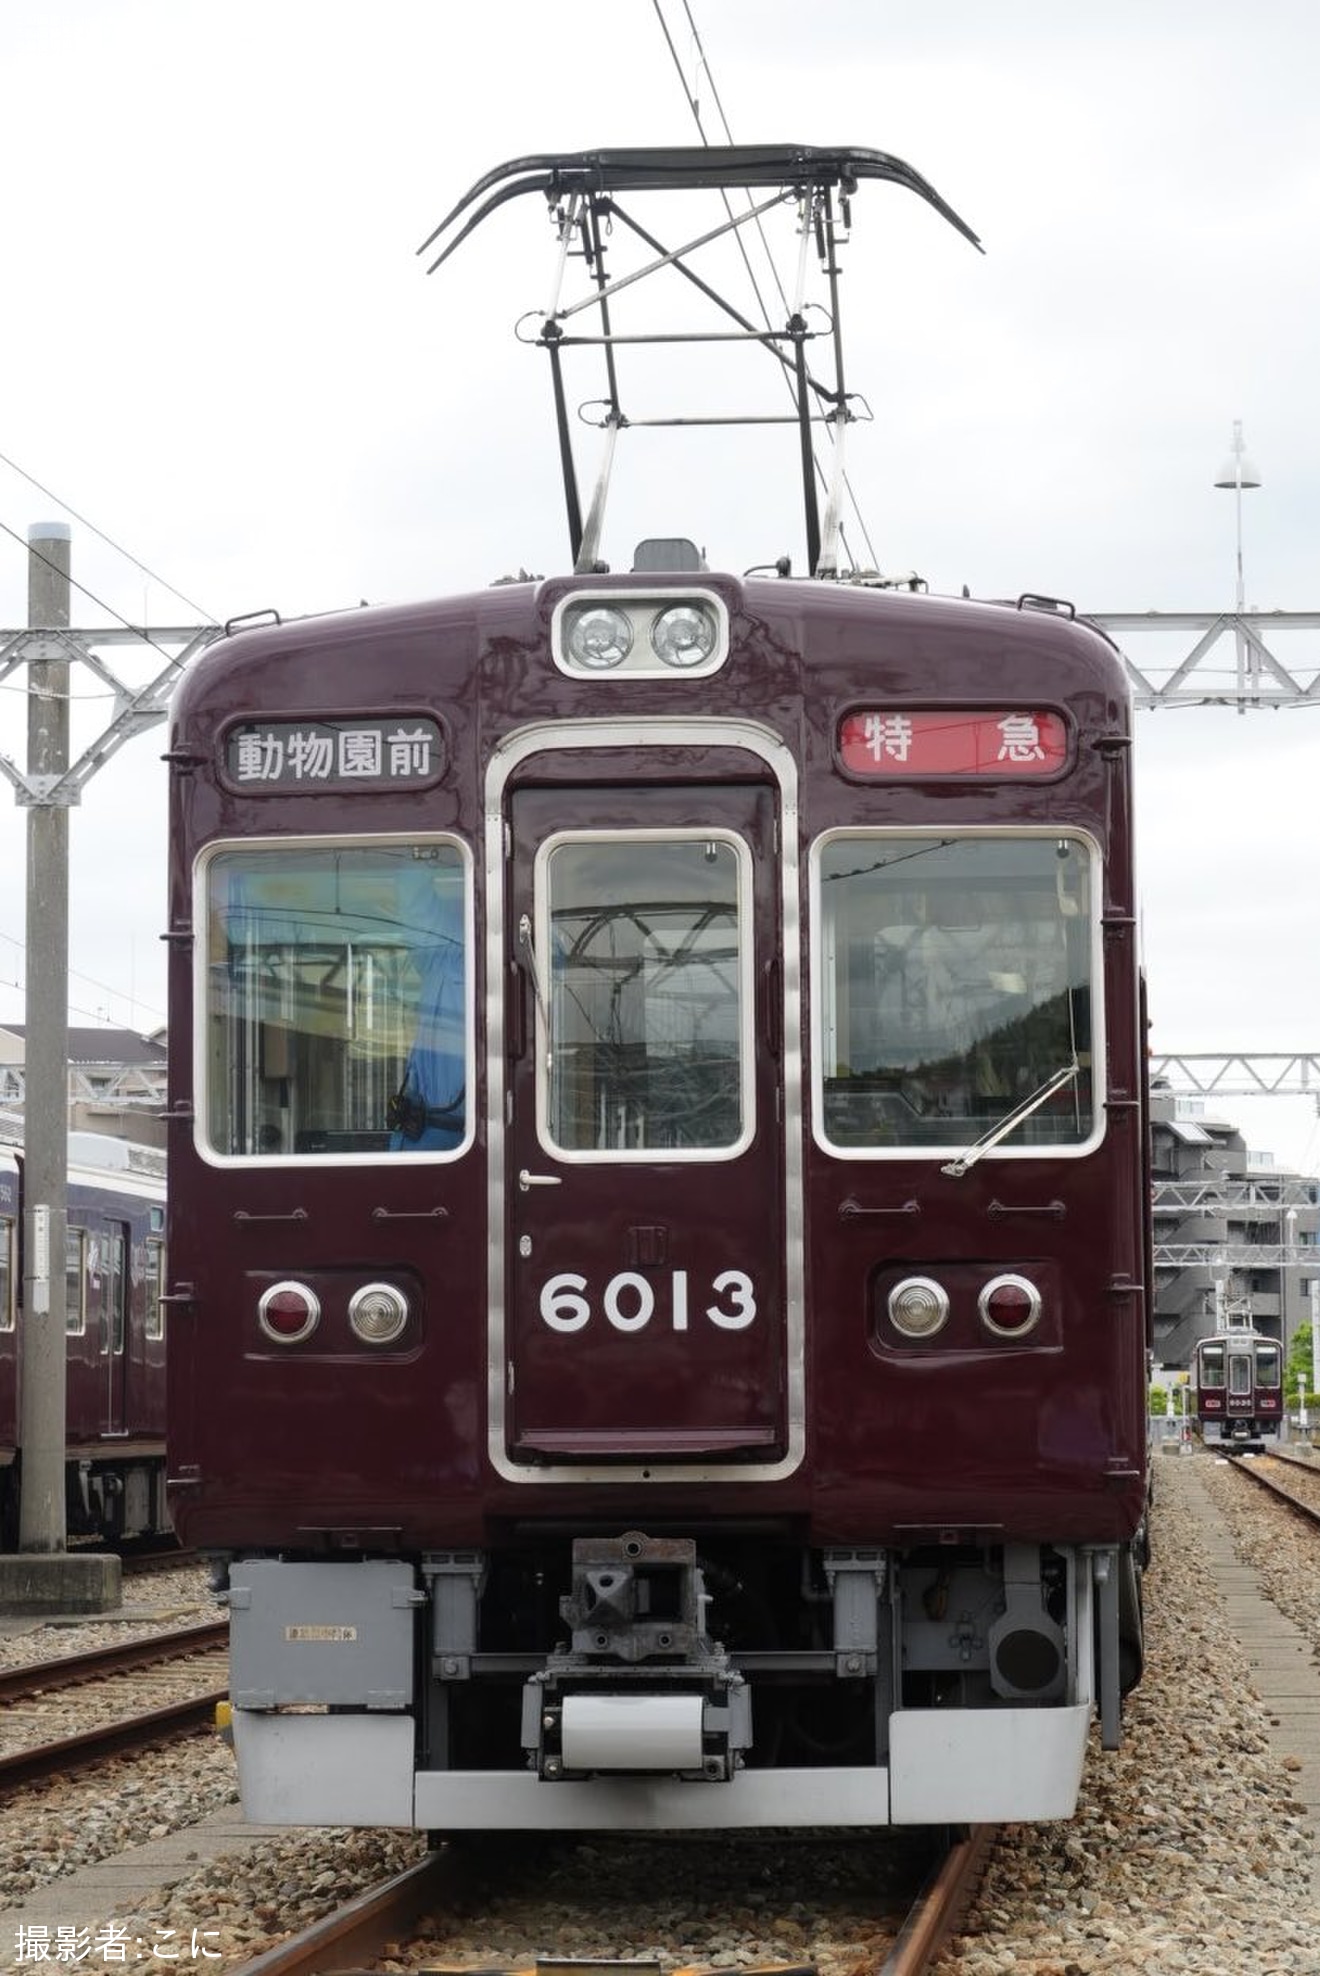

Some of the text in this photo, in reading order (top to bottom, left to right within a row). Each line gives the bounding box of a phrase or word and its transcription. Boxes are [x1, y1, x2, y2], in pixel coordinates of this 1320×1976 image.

[238, 728, 433, 780] 動物園前
[540, 1270, 757, 1332] 6013
